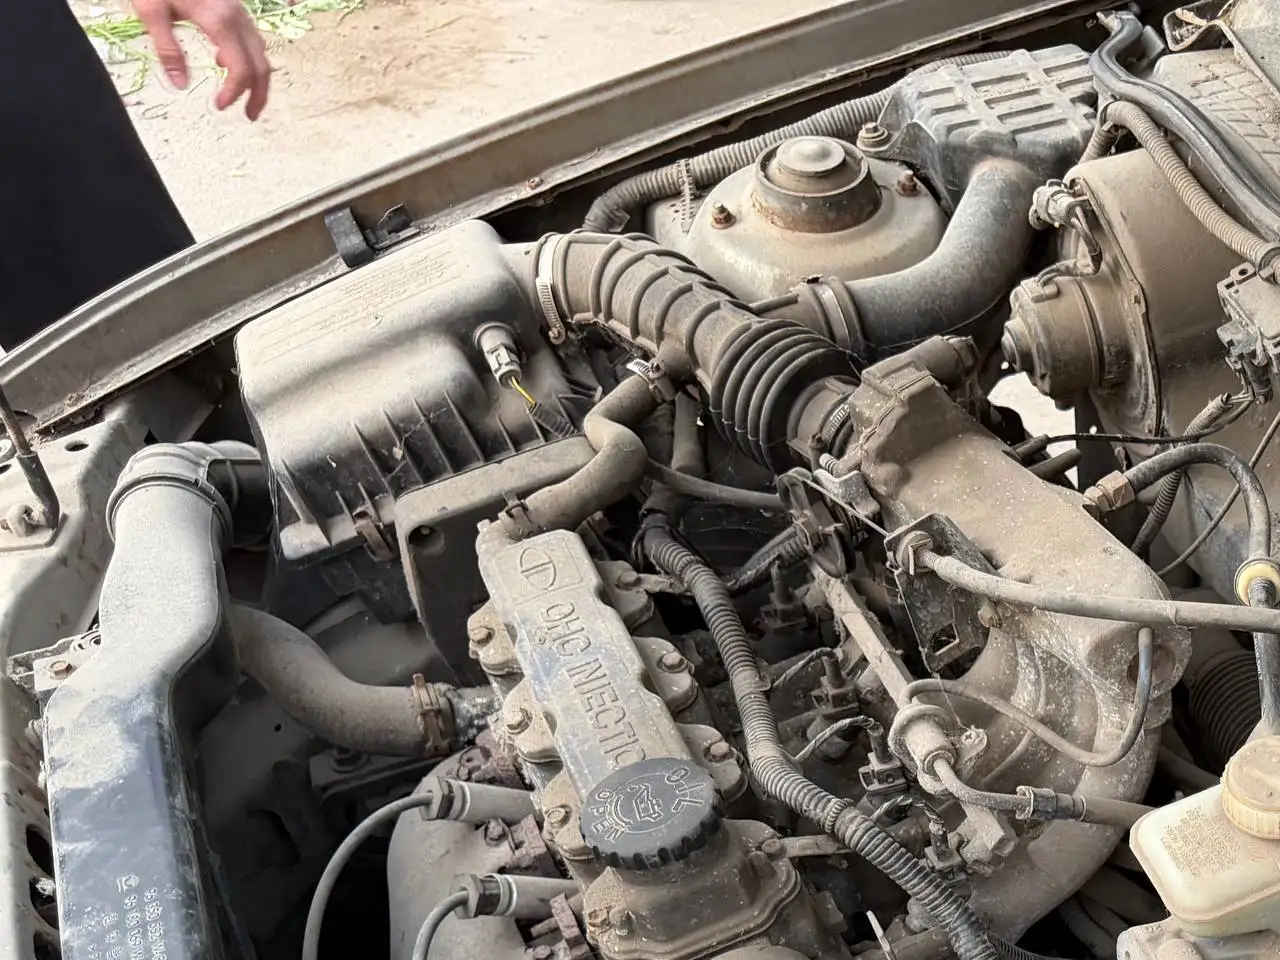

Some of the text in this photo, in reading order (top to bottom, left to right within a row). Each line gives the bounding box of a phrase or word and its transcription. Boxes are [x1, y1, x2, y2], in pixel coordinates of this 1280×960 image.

[542, 602, 646, 767] OHC INJECTIO
[588, 789, 625, 843] OPEN
[664, 766, 706, 813] OIL
